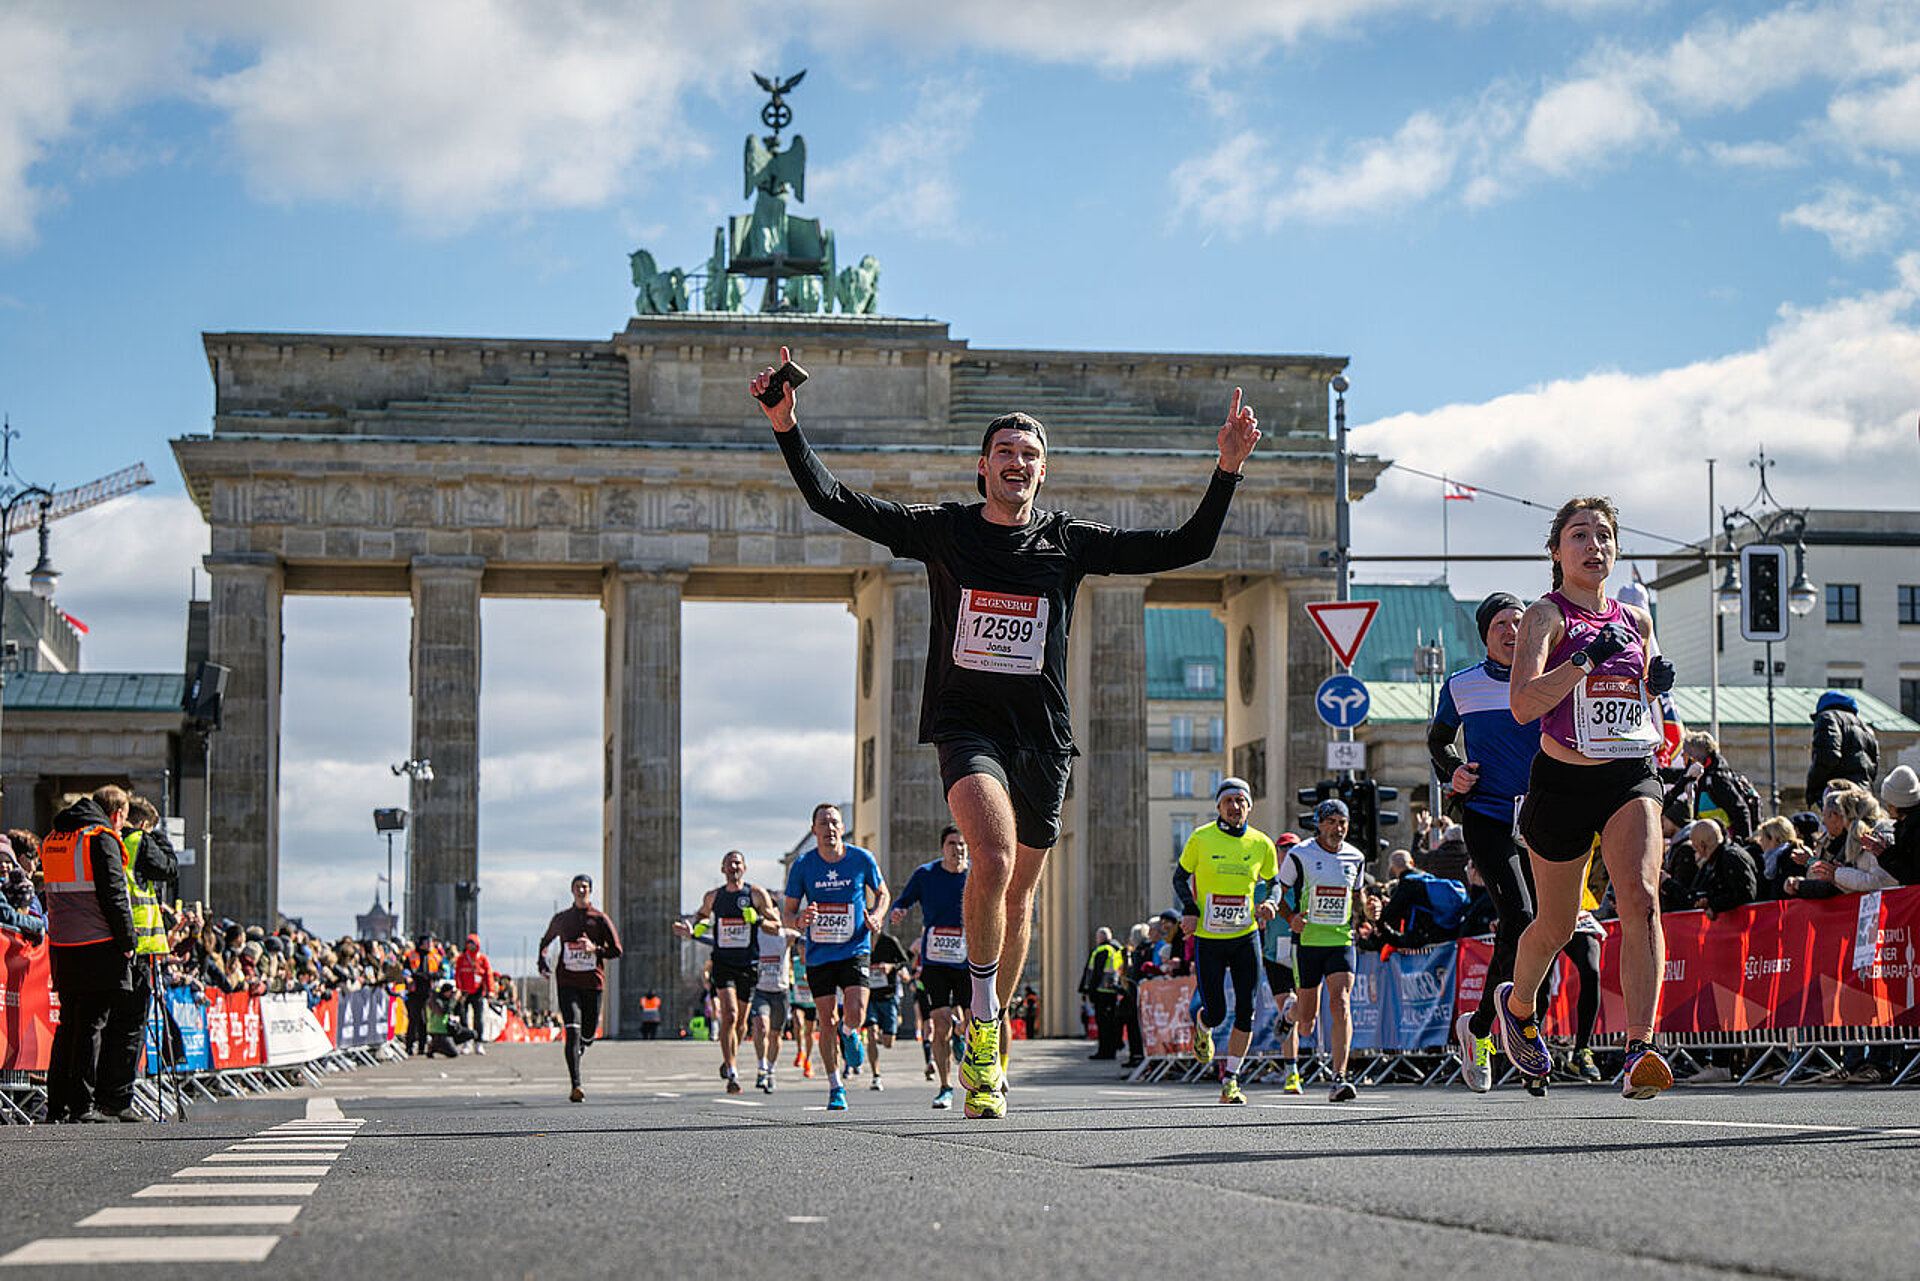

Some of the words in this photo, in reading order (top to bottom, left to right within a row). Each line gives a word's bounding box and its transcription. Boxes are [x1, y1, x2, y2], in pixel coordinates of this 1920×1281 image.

[988, 599, 1033, 611] GENERALI
[972, 616, 1033, 643] 12599
[986, 642, 1012, 653] Jonas
[1591, 701, 1641, 727] 38748
[1317, 897, 1345, 910] 12563
[1213, 906, 1245, 920] 34975
[816, 915, 847, 927] 22646
[934, 936, 961, 949] 20396
